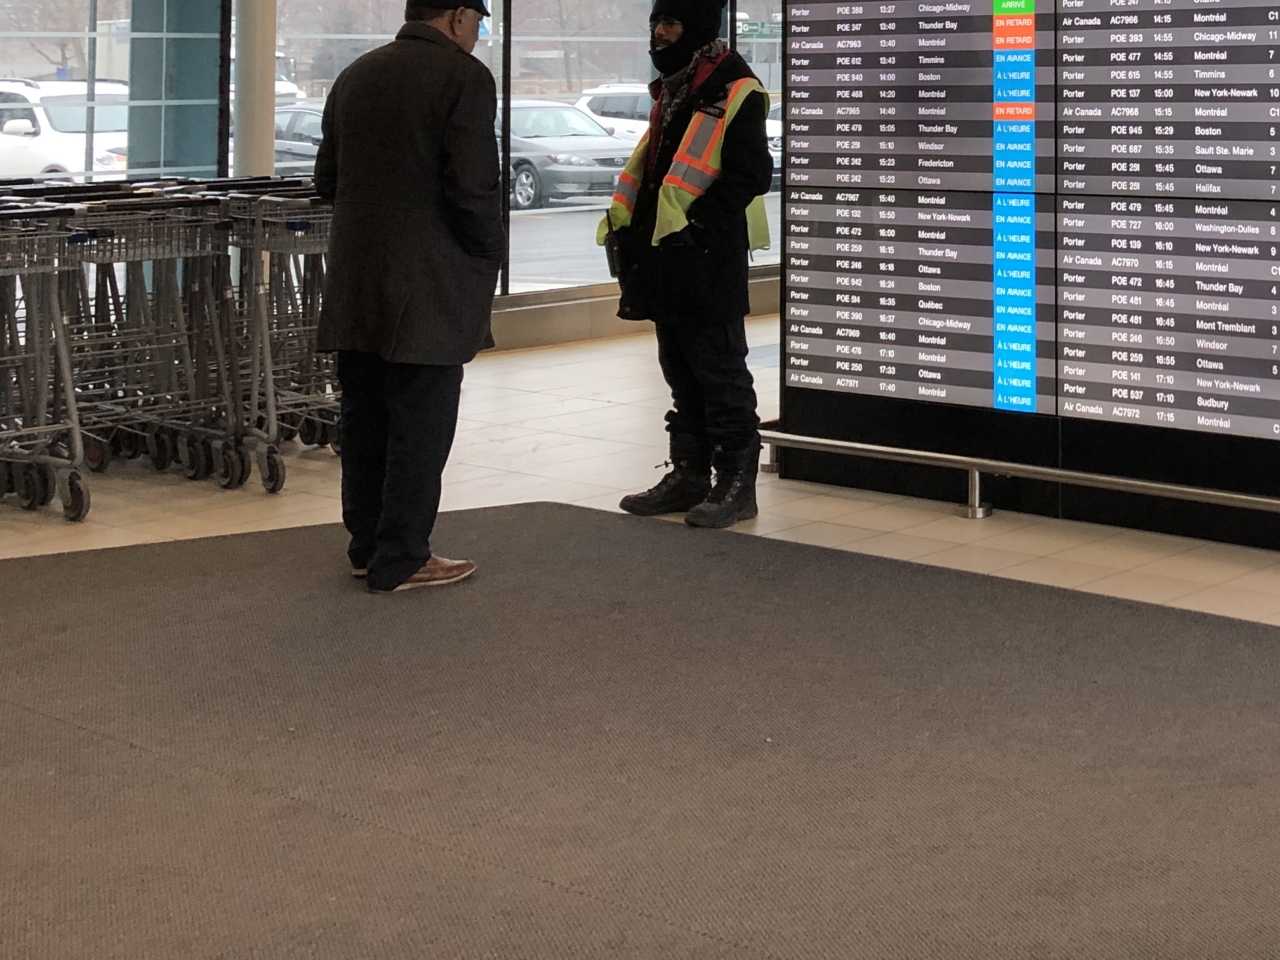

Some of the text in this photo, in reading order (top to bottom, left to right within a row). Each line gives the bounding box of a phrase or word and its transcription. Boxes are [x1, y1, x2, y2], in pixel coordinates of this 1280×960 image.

[919, 3, 970, 13] Chicago-Midway
[1002, 0, 1025, 8] ARRIVÉ
[1006, 36, 1032, 44] RETARD
[1111, 71, 1126, 79] POE
[1128, 71, 1140, 79] 615
[1194, 70, 1225, 78] Timmins
[1269, 69, 1274, 78] 6
[1064, 126, 1085, 134] Porter
[1111, 126, 1127, 134] POE
[1129, 126, 1142, 134] 945
[1155, 126, 1173, 135] 15:29
[1195, 126, 1221, 135] Boston
[1270, 127, 1275, 136] 5
[800, 374, 823, 384] Canada
[880, 383, 895, 391] 17:40
[919, 387, 946, 397] Montréal
[998, 394, 1003, 402] À
[1005, 395, 1031, 407] L'HEURE
[1064, 402, 1074, 410] Air
[1076, 403, 1103, 414] Canada
[1157, 412, 1174, 422] 17:15
[1198, 416, 1230, 427] Montréal
